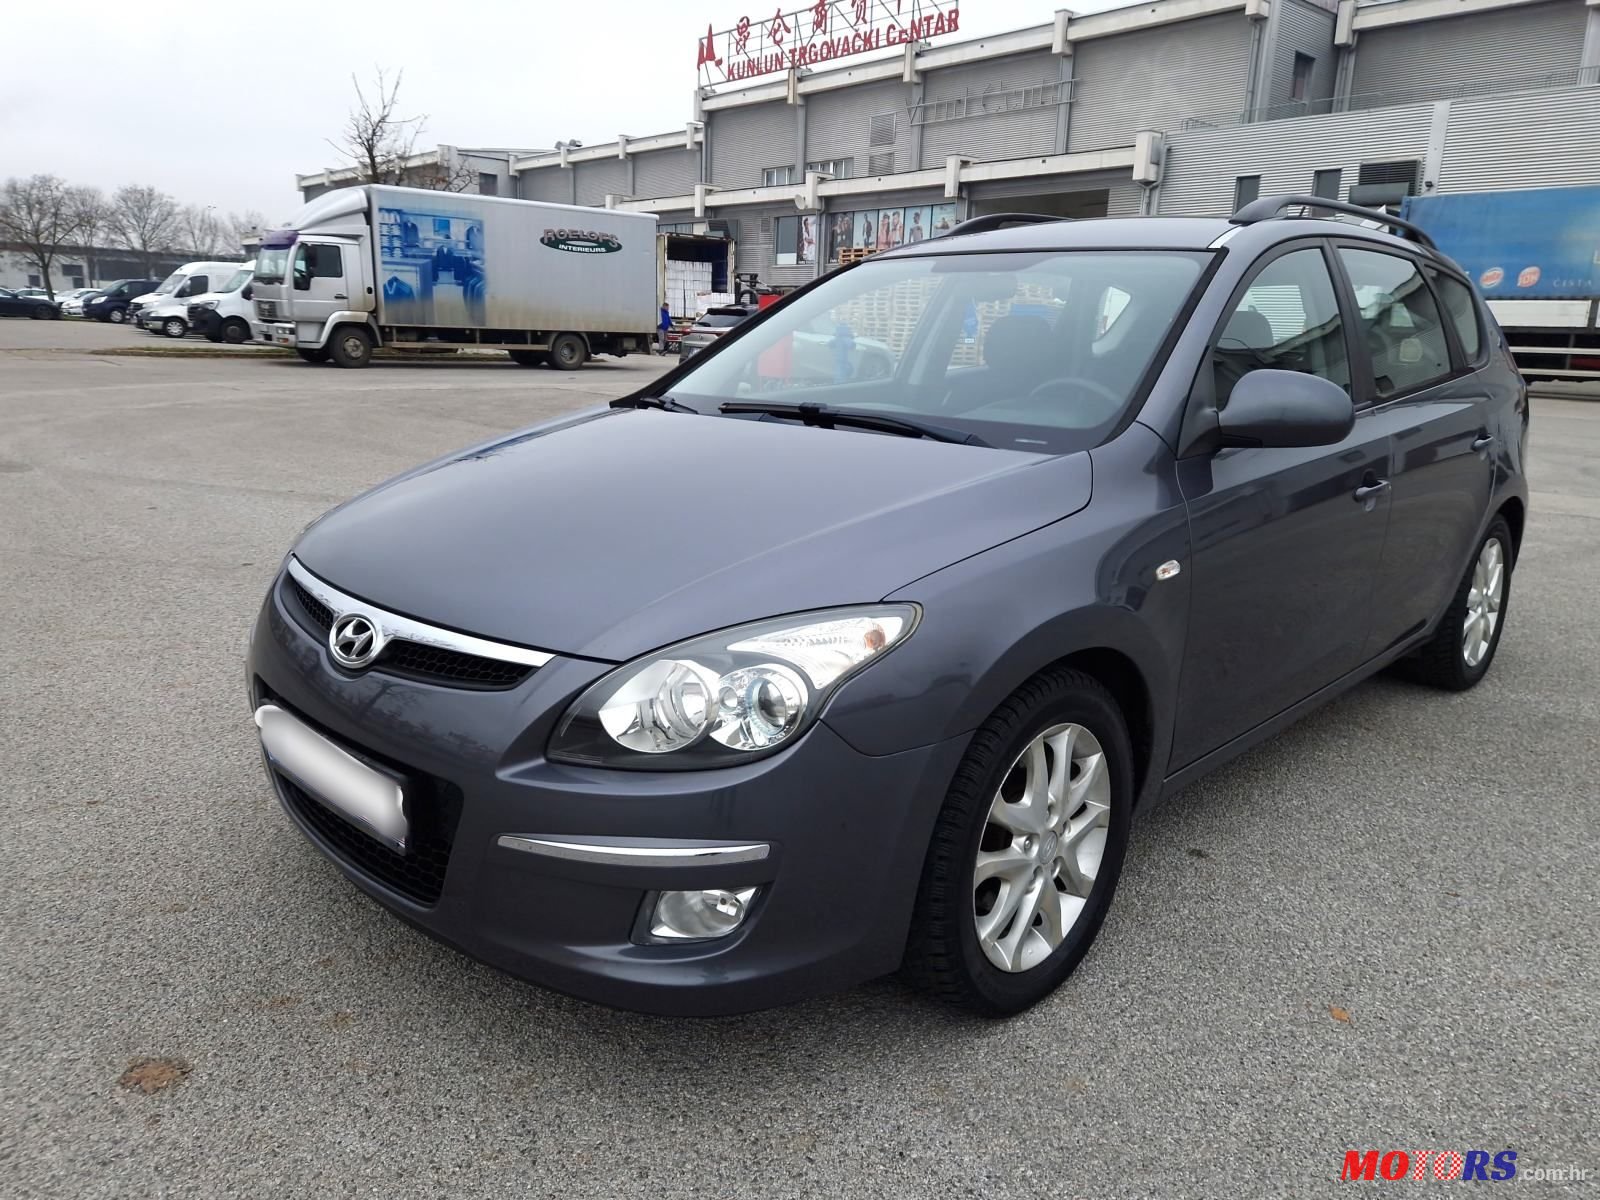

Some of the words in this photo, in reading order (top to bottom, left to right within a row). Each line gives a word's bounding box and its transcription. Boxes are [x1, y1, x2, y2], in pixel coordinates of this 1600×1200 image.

[728, 51, 784, 81] KUNLUN
[789, 27, 880, 67] TRGOVAČKI
[886, 8, 960, 47] CENTAR
[543, 228, 619, 248] ROELOFS
[558, 243, 607, 253] INTERIEURS
